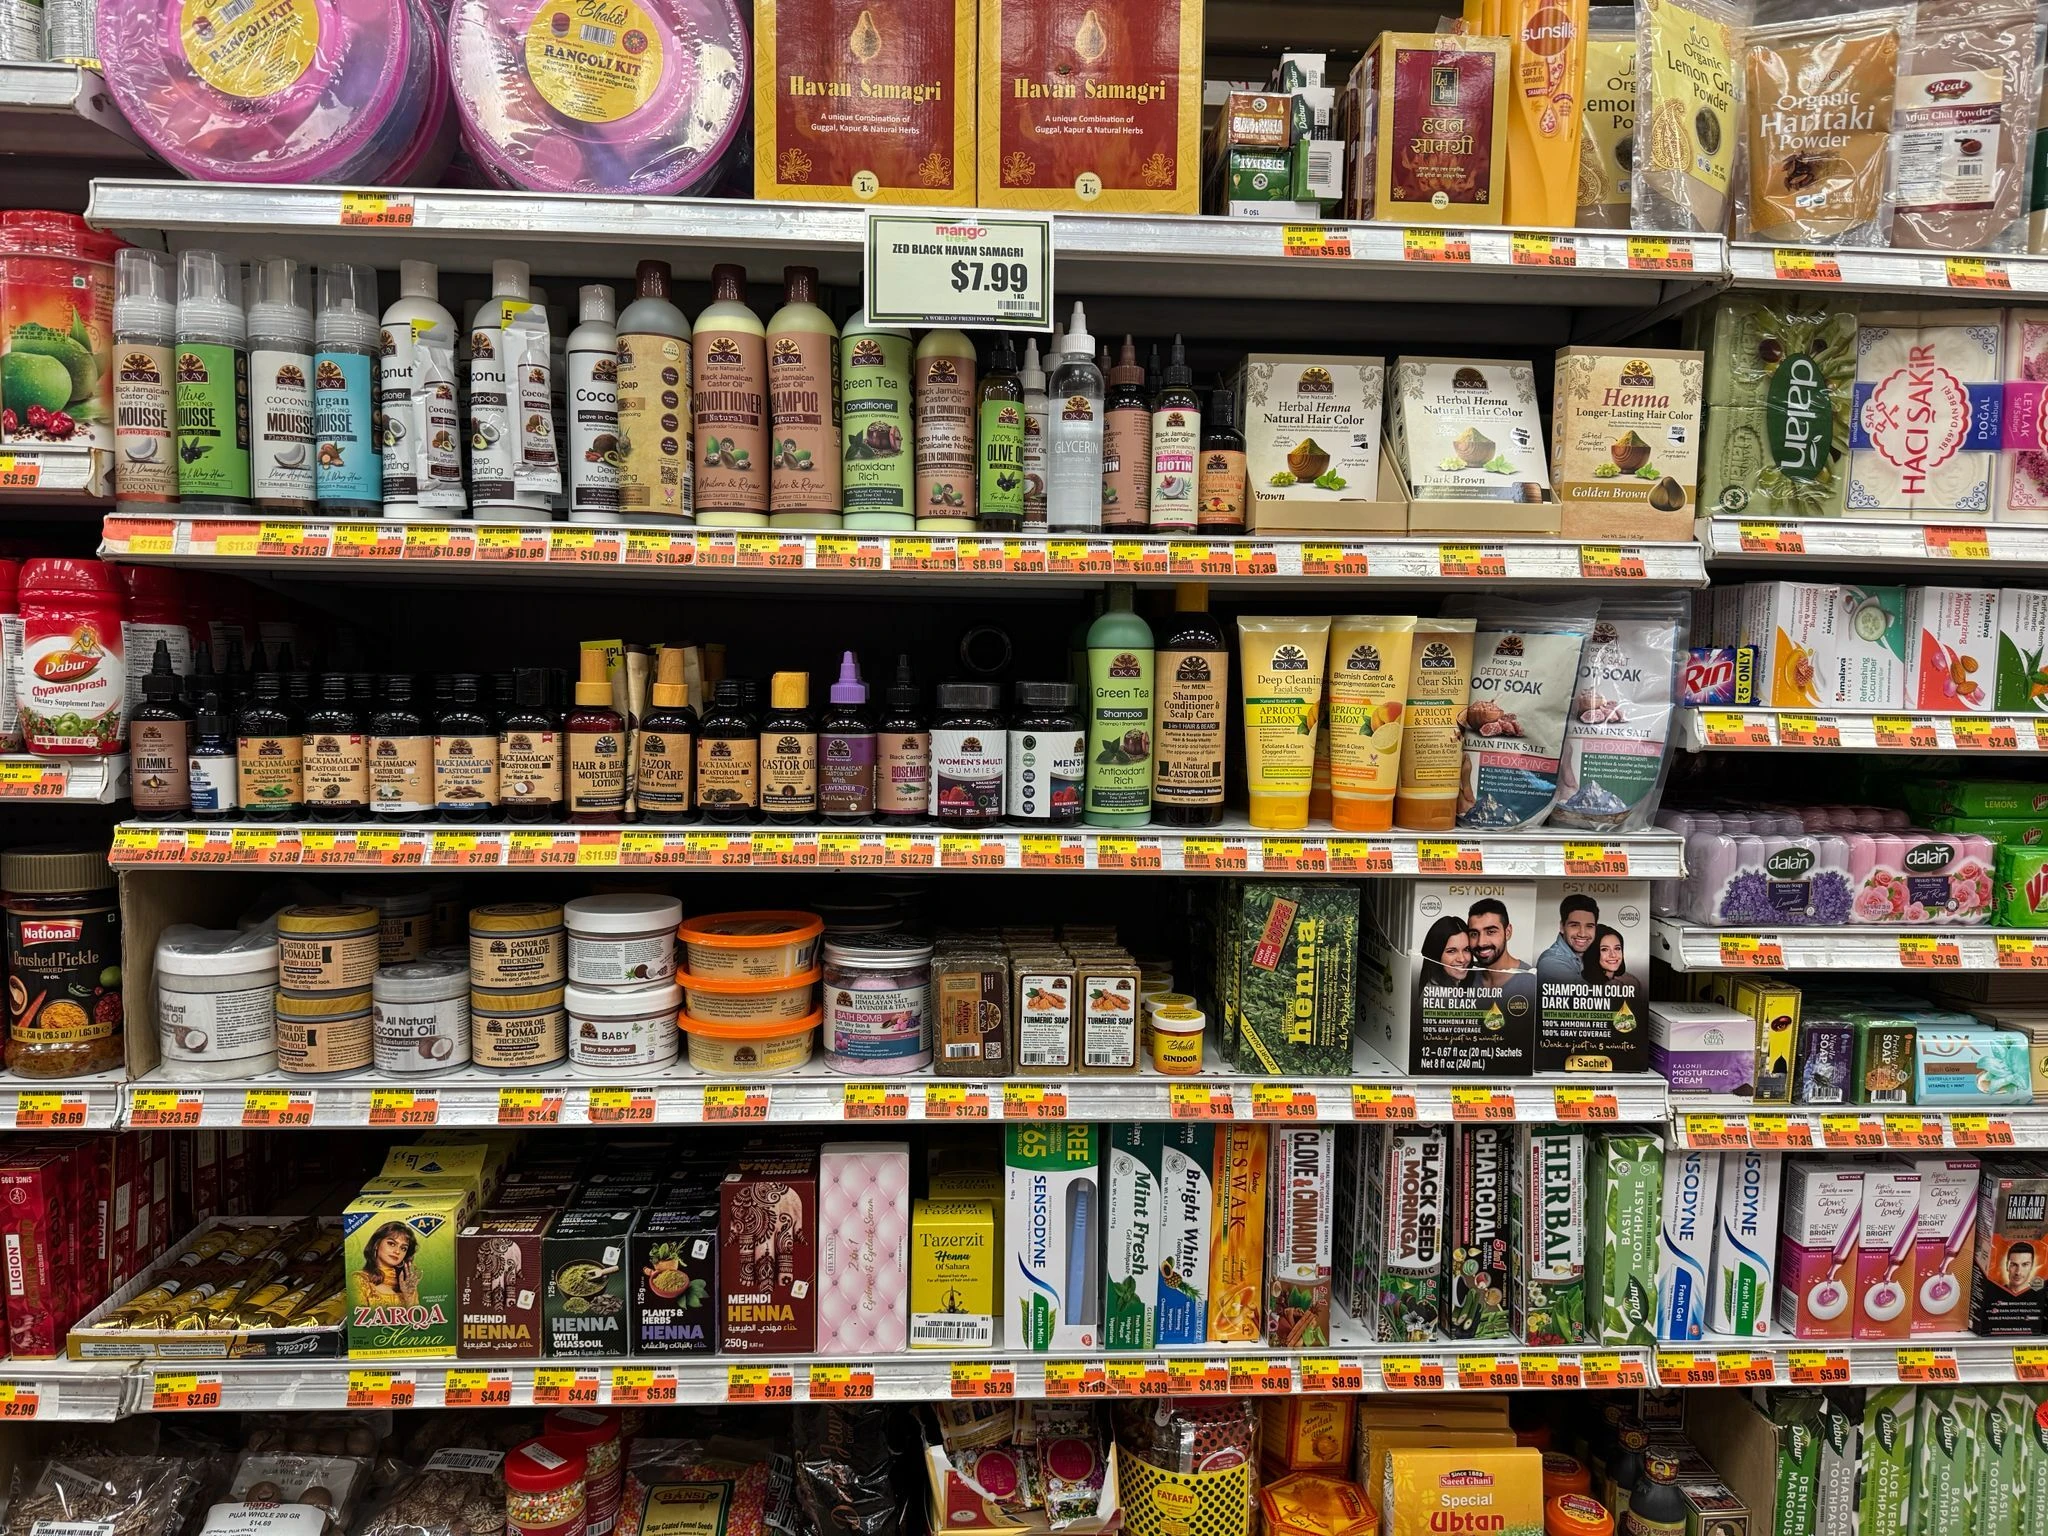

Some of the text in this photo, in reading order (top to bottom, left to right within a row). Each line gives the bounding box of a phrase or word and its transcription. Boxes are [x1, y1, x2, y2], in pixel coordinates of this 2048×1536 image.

[1521, 22, 1577, 41] sunsilk
[544, 45, 641, 77] RANGOLI KIT
[789, 76, 941, 105] Havan Samagri
[1013, 77, 1165, 105] Havan Samagri
[1777, 90, 1860, 111] Organic
[821, 113, 910, 123] A unique Combination of
[1761, 105, 1875, 137] Haritaki
[811, 123, 837, 134] Guggal,
[840, 124, 861, 134] Kapur
[870, 125, 896, 134] Natural
[898, 126, 920, 135] Herbs
[1780, 132, 1850, 150] Powder
[376, 212, 413, 224] $19.69
[936, 225, 987, 240] mango
[892, 244, 1023, 257] ZED BLACK HAVAN SAMAGRI
[1321, 247, 1351, 257] $5.99
[951, 260, 1028, 292] $7.99
[121, 372, 157, 382] OKAY
[843, 376, 897, 390] Green Tea
[695, 390, 762, 415] CONDITIONER
[1602, 387, 1670, 409] Henna
[846, 401, 893, 411] Conditioner
[1278, 401, 1351, 414] Herbal Henna
[118, 408, 168, 428] MOUSSE
[708, 414, 743, 422] Natural
[1263, 413, 1364, 425] Natural Hair Color
[1575, 408, 1693, 421] Longer-Lasting Hair Color
[987, 444, 1011, 462] OLIVE
[1055, 442, 1098, 454] GLYCERIN
[847, 462, 895, 472] Antioxidant
[1156, 460, 1192, 472] BIOTIN
[1901, 428, 1929, 494] HACI
[3, 472, 36, 486] $8.59
[858, 471, 879, 482] Rich
[1572, 486, 1647, 500] Golden Brown
[291, 545, 328, 557] $11.39
[1775, 542, 1802, 553] $7.39
[769, 554, 803, 566] $12.79
[850, 557, 881, 568] $11.79
[1333, 563, 1367, 575] $10.79
[45, 660, 88, 676] Dabur
[1739, 652, 1750, 681] ONLY
[1416, 676, 1463, 686] Clear Skin
[32, 678, 107, 697] Chyawanprash
[1096, 686, 1130, 700] Green
[1503, 680, 1541, 695] SOAK
[1173, 692, 1213, 702] Shampoo
[54, 699, 90, 708] Supplement
[1164, 700, 1214, 710] Conditioner
[1103, 709, 1143, 721] Shampoo
[1169, 709, 1215, 719] Scalp Care
[1260, 707, 1302, 716] APRICOT
[1260, 716, 1295, 725] LEMON
[1812, 736, 1840, 746] $2.49
[136, 758, 164, 769] VITAMIN
[761, 759, 799, 770] CASTOR
[938, 758, 980, 766] WOMEN'S
[1482, 754, 1550, 772] DETOXIFYING
[892, 766, 926, 778] ROSEMARY
[592, 778, 620, 788] LOTION
[32, 784, 63, 795] $8.79
[269, 851, 300, 863] $7.39
[24, 926, 77, 940] National
[283, 948, 321, 960] POMADE
[510, 945, 550, 957] POMADE
[13, 950, 99, 968] Crushed Pickle
[1752, 953, 1781, 966] $2.69
[1289, 920, 1316, 1045] henna
[1423, 986, 1502, 998] SHAMPOO-IN COLOR
[1423, 999, 1476, 1009] REAL BLACK
[1542, 996, 1610, 1010] DARK BROWN
[386, 1016, 436, 1025] All Natural
[837, 1012, 882, 1022] BATH BOMB
[1054, 1017, 1069, 1025] SOAP
[601, 1031, 629, 1040] BABY
[1918, 1033, 1981, 1057] LUX
[1163, 1054, 1197, 1063] SINDOOR
[1570, 1058, 1608, 1068] 1 Sachet
[1673, 1069, 1729, 1077] MOISTURIZING
[1673, 1076, 1703, 1085] CREAM
[732, 1105, 766, 1117] $13.29
[1484, 1106, 1513, 1118] $3.99
[51, 1112, 83, 1125] $8.69
[1986, 1131, 2012, 1145] $1.99
[1475, 1128, 1497, 1245] CHARCOAL
[1544, 1136, 1571, 1267] HERBAL
[1399, 1160, 1420, 1260] MORINGA
[2008, 1206, 2044, 1220] HANDSOME
[1032, 1174, 1047, 1269] SENSODYNE
[1631, 1180, 1645, 1271] TOOTHPASTE
[920, 1232, 984, 1248] Tazerzit
[9, 1247, 22, 1290] LIGION
[354, 1305, 448, 1329] ZARQA
[463, 1314, 506, 1324] MEHNDI
[642, 1309, 683, 1318] PLANTS &
[642, 1317, 671, 1325] HERBS
[463, 1324, 530, 1339] HENNA
[553, 1340, 603, 1348] GHASSOUL
[1928, 1365, 1955, 1379] $9.99
[186, 1393, 218, 1406] $2.69
[1441, 1493, 1493, 1509] Special
[1430, 1512, 1505, 1532] Ubtan
